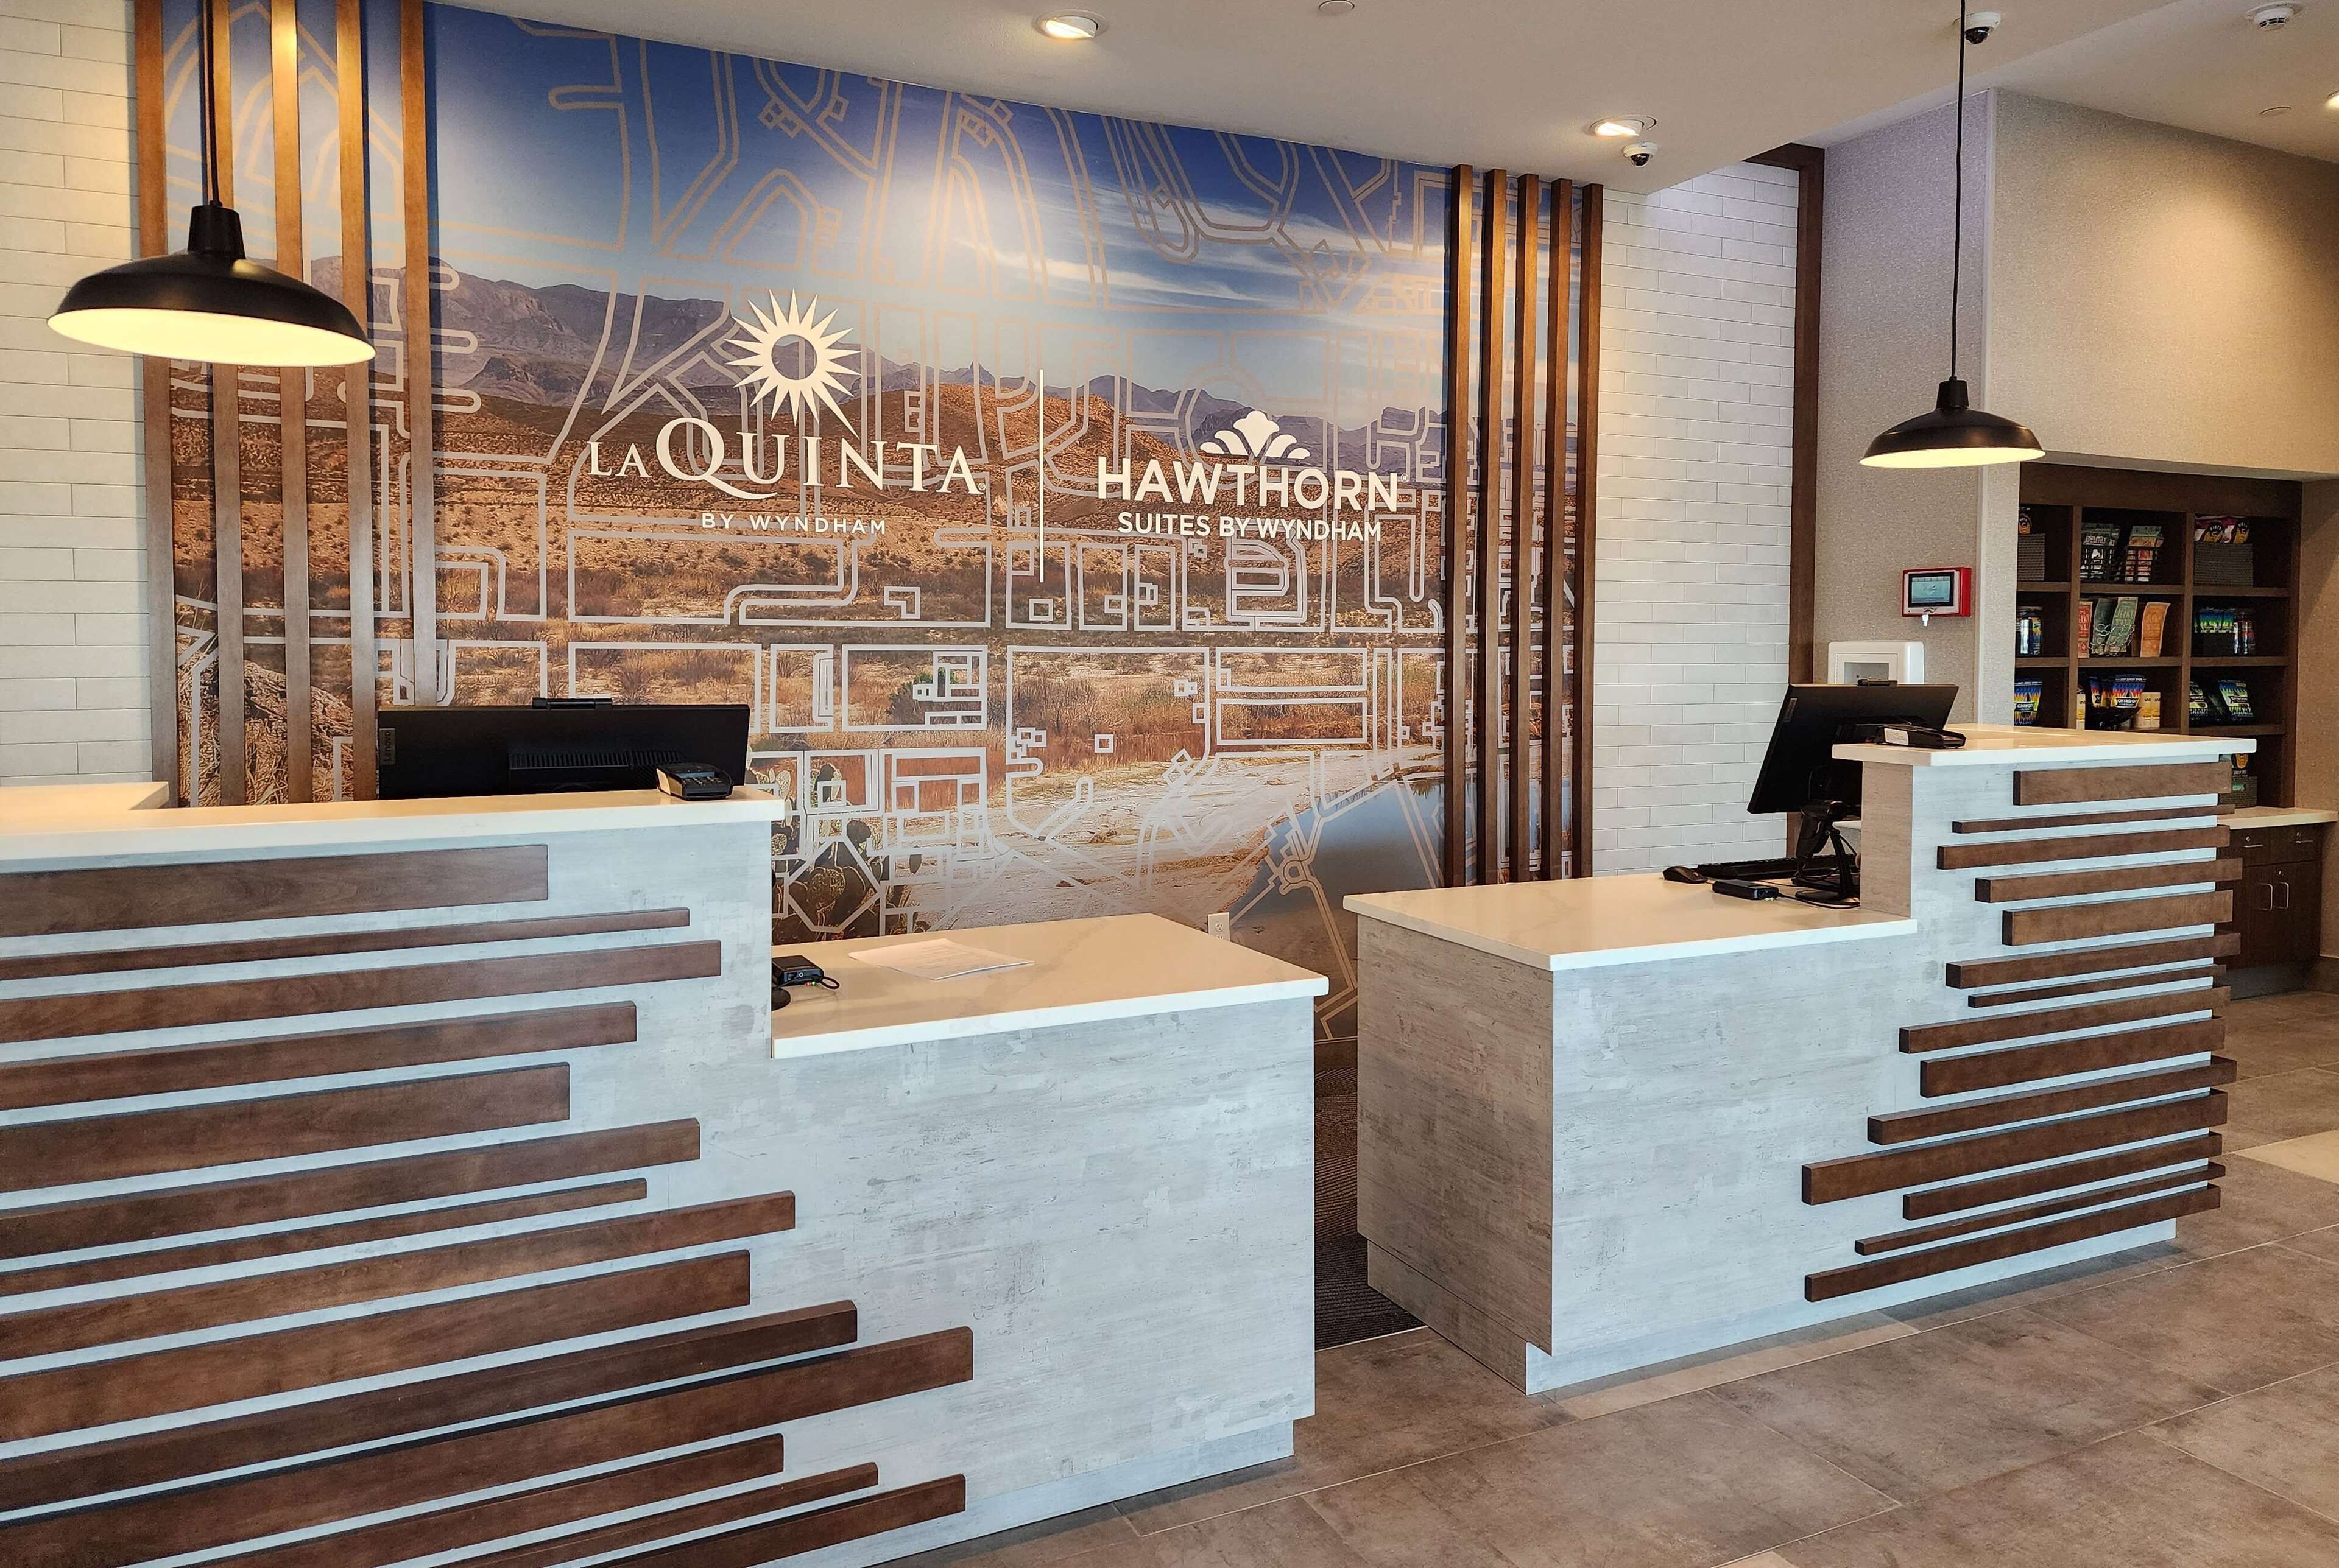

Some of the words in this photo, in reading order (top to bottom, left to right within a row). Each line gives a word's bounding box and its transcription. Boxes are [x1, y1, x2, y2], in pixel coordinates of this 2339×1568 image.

[588, 441, 652, 478] LA
[656, 417, 986, 500] QUINTA
[1097, 456, 1398, 512] HAWTHORN
[702, 513, 735, 529] BY
[750, 515, 886, 534] WYNDHAM
[1117, 512, 1211, 536] SUITES
[1219, 517, 1249, 538] BY
[1256, 518, 1381, 541] WYNDHAM
